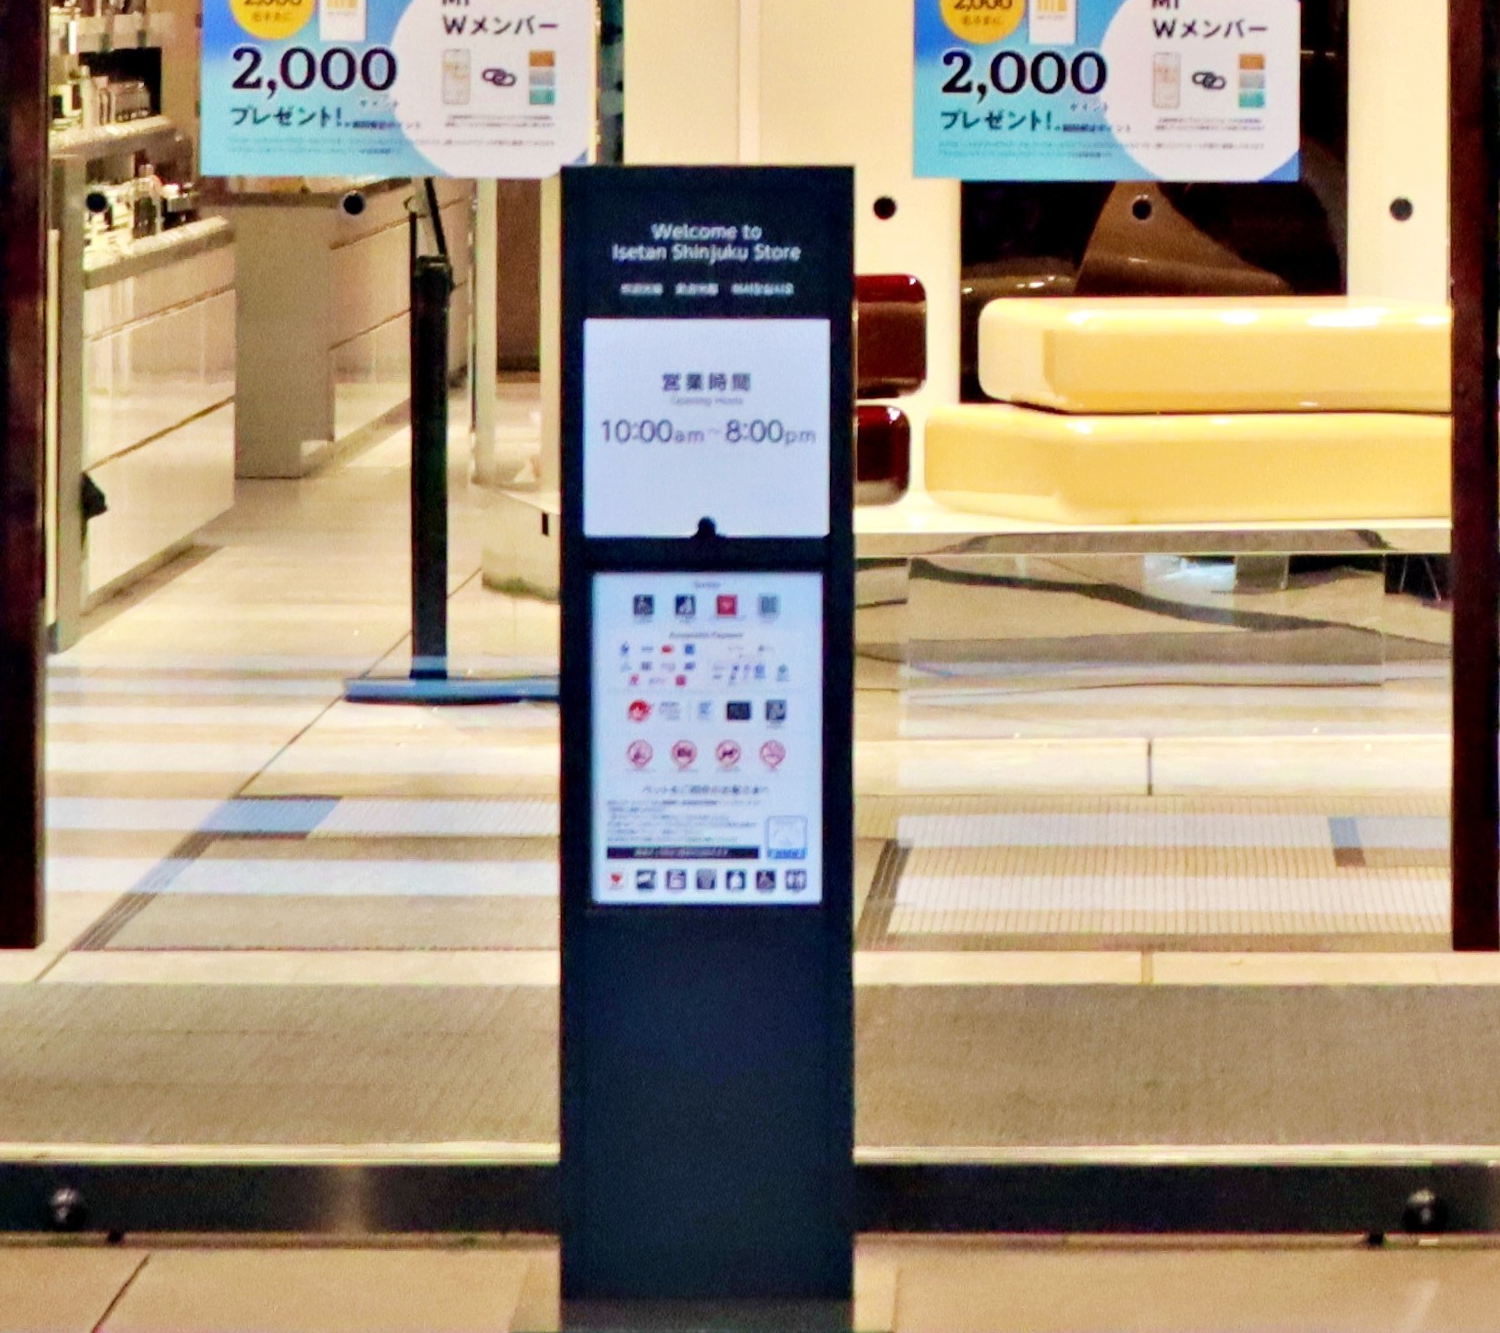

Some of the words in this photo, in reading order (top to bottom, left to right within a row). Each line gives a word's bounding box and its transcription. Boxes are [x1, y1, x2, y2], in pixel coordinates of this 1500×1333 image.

[443, 15, 558, 35] Wメンバー
[1152, 19, 1267, 39] Wメンバー
[232, 46, 398, 100] 2,000
[941, 50, 1108, 104] 2,000
[651, 223, 738, 241] Welcome
[742, 224, 763, 241] to
[612, 243, 667, 261] Isetan
[672, 243, 749, 265] Shinjuku
[754, 243, 801, 261] Store
[662, 373, 751, 392] 営業時間
